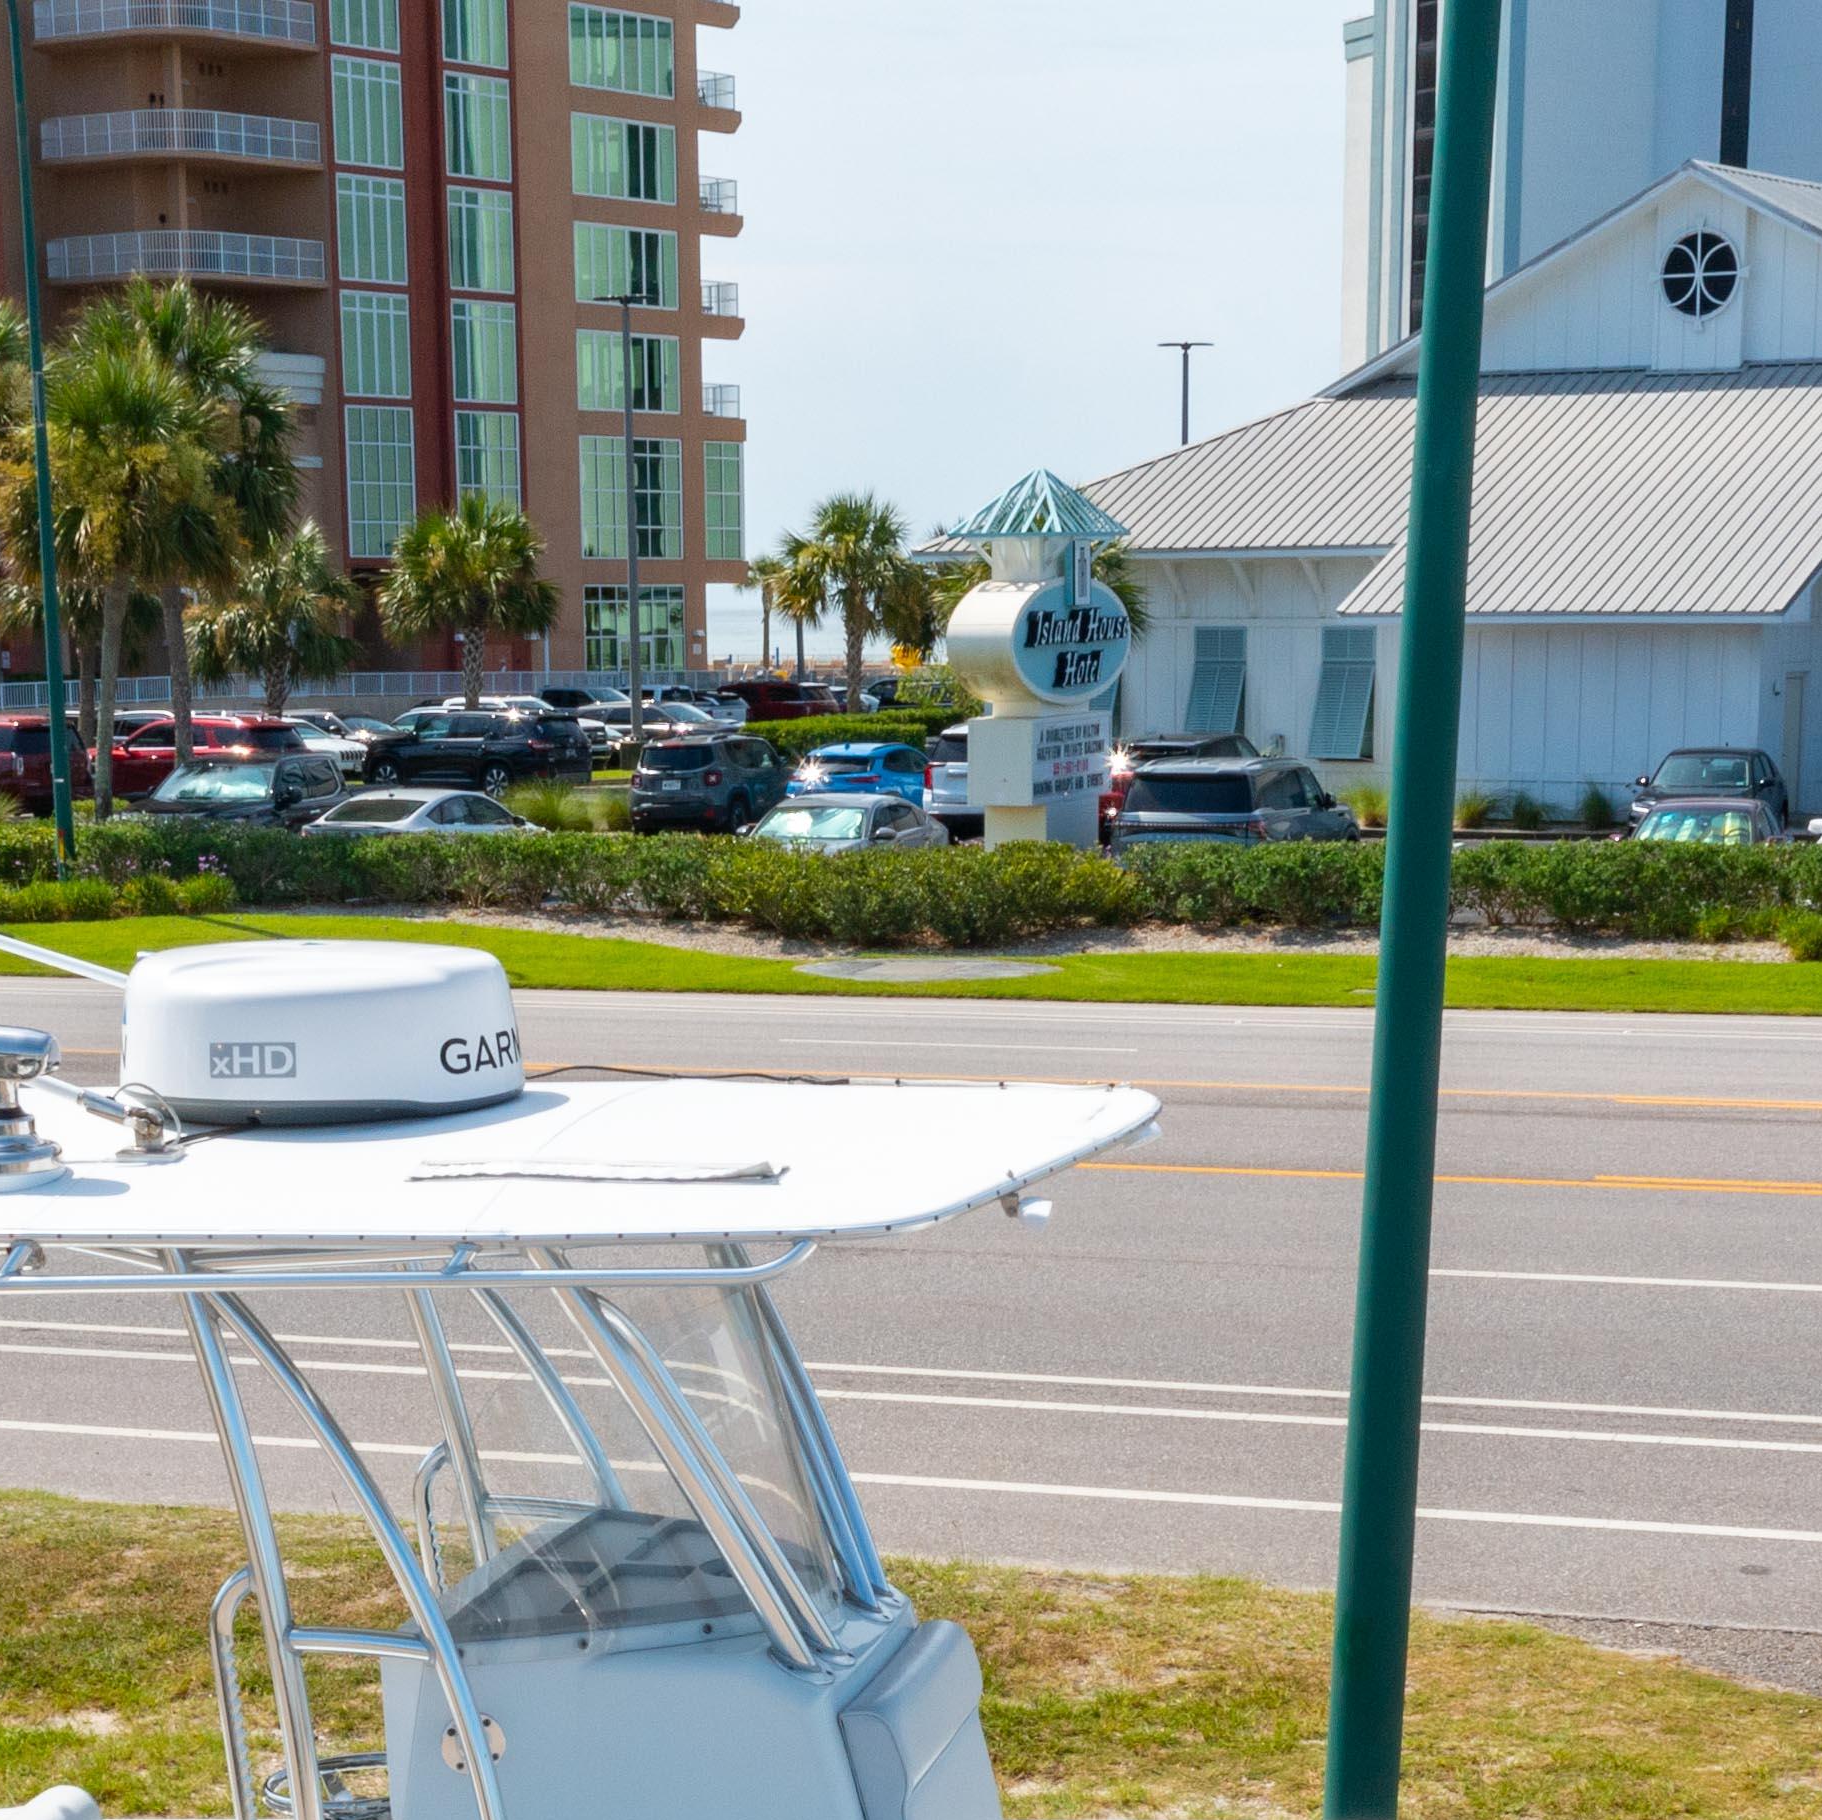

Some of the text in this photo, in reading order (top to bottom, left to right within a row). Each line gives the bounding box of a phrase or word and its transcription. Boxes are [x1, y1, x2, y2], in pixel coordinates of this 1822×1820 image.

[1033, 608, 1129, 647] Island House
[1062, 650, 1103, 687] Hotel
[211, 1044, 295, 1078] xHD
